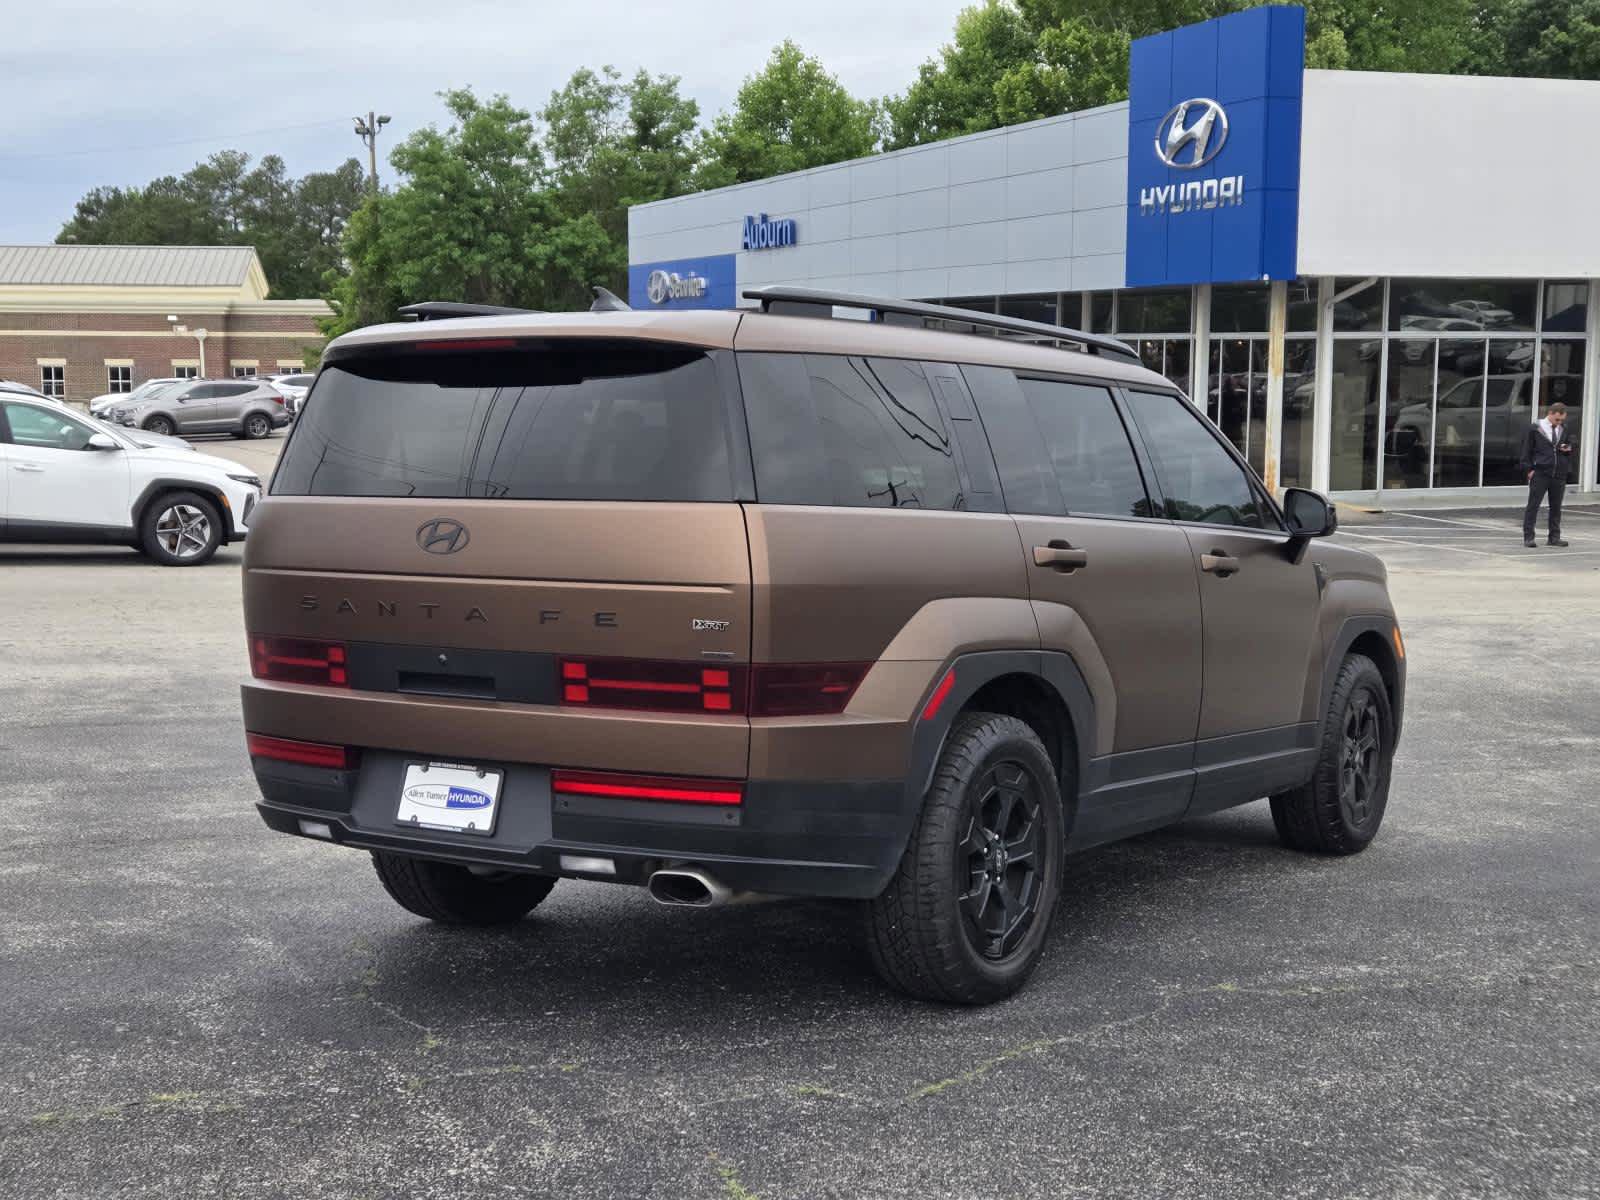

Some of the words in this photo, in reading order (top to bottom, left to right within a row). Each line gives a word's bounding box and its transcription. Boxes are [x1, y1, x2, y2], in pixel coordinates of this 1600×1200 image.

[1140, 176, 1244, 216] HYUNDAI
[742, 213, 797, 249] Auburn
[299, 594, 489, 624] SANTA
[538, 609, 618, 628] FE
[448, 792, 486, 805] HYUNDAI
